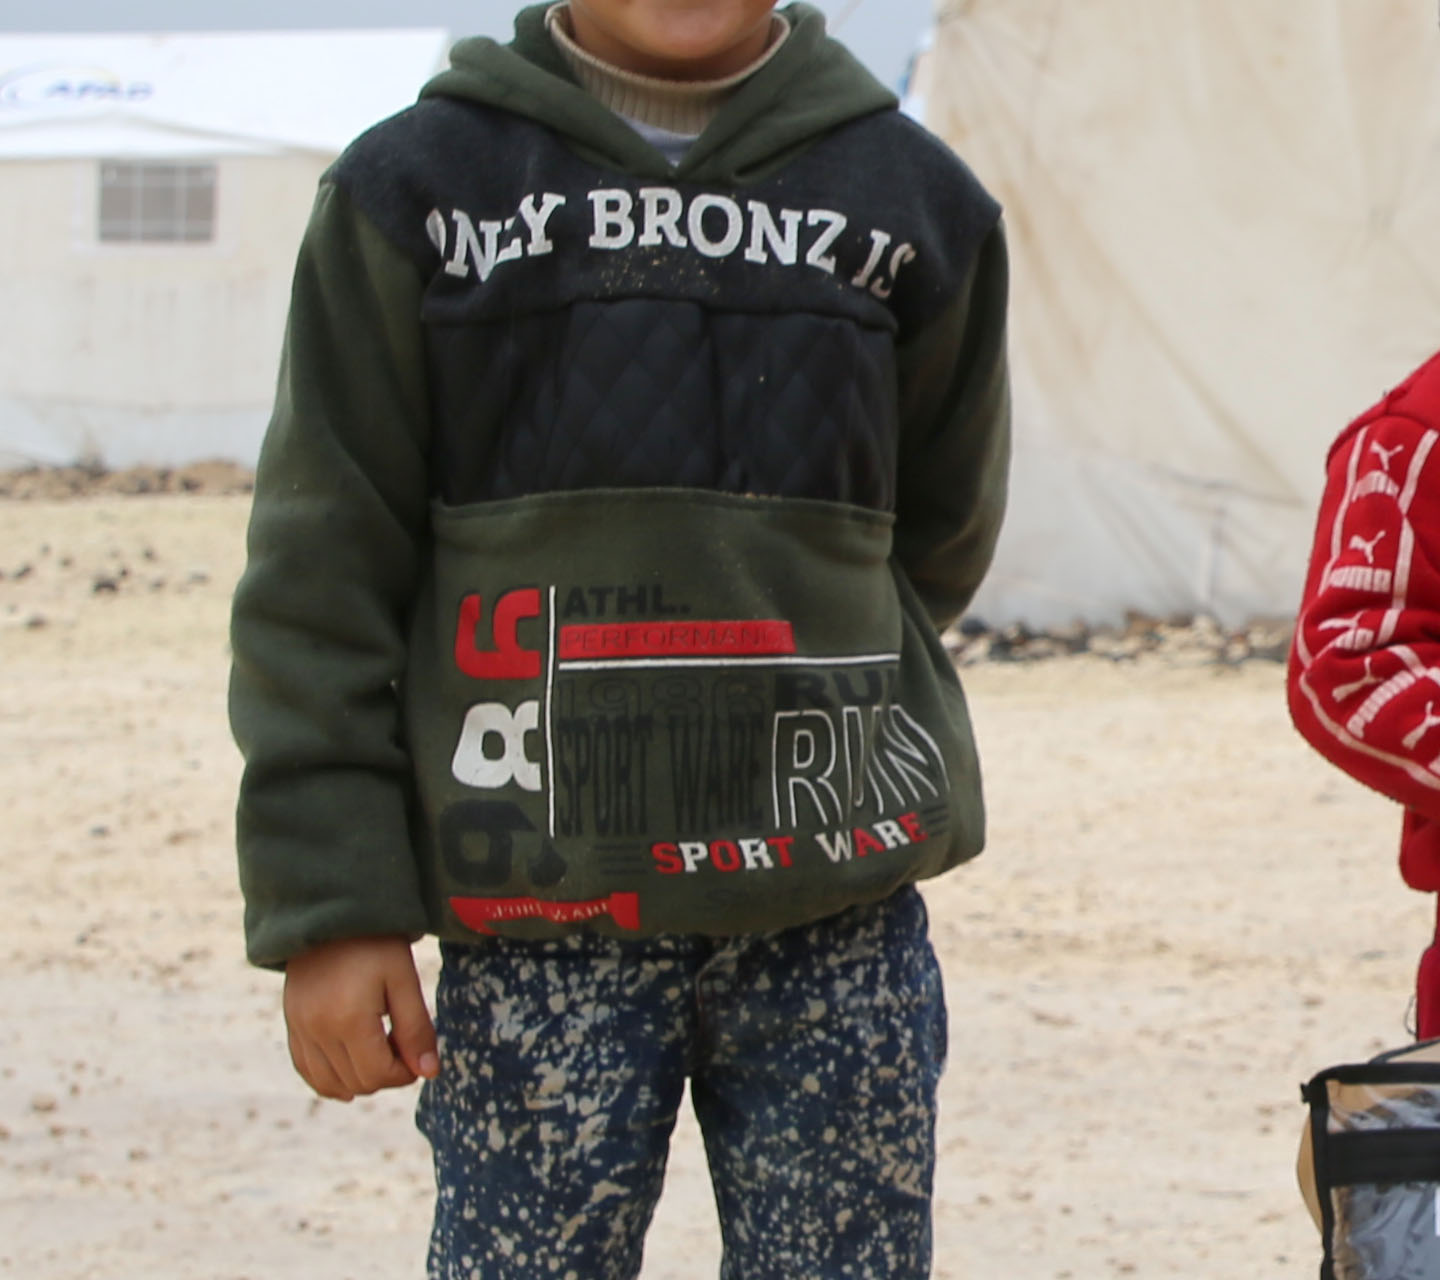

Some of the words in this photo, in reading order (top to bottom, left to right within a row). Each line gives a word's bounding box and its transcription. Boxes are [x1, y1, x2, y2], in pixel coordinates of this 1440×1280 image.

[587, 186, 849, 274] BRONZ
[651, 835, 795, 875] SPORT
[815, 812, 929, 863] WARE
